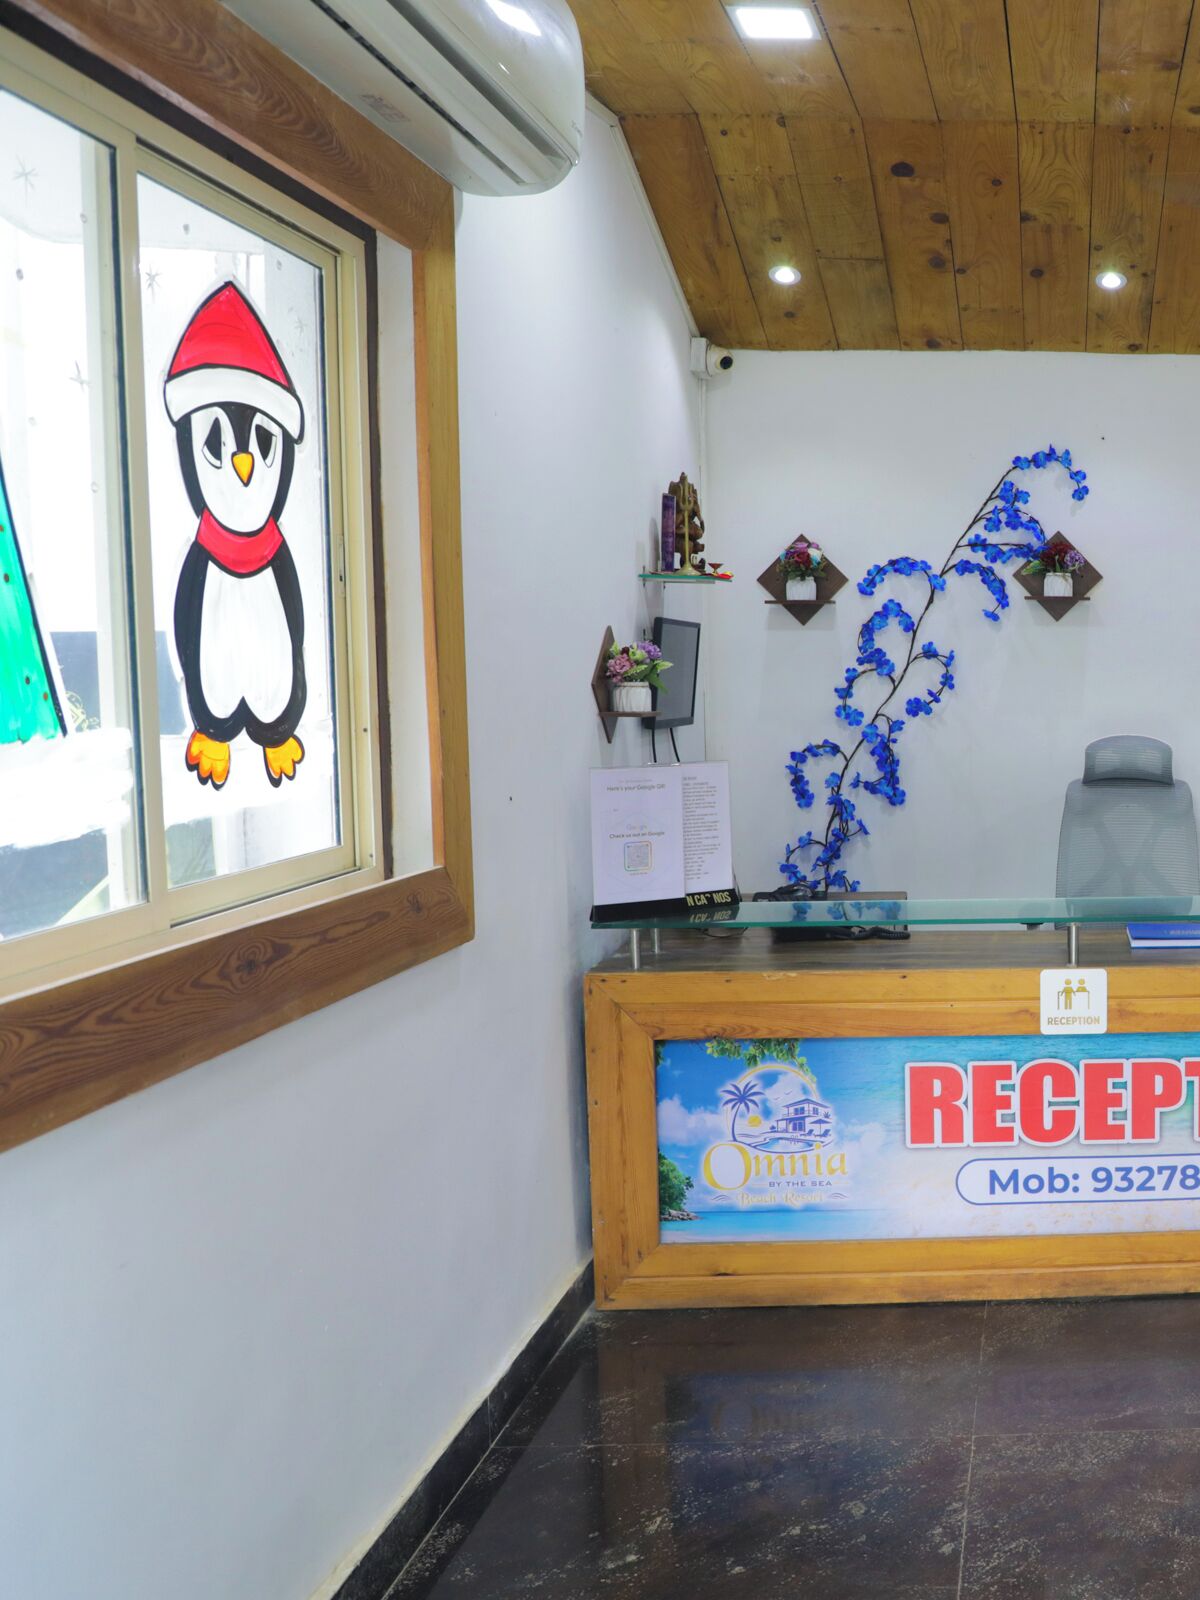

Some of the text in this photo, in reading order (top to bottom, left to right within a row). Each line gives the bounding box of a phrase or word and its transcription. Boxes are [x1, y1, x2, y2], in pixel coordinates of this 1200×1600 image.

[1047, 1016, 1100, 1026] RECEPTION
[703, 1142, 849, 1191] Omnia
[785, 1180, 807, 1188] THE
[989, 1166, 1080, 1196] Mob:
